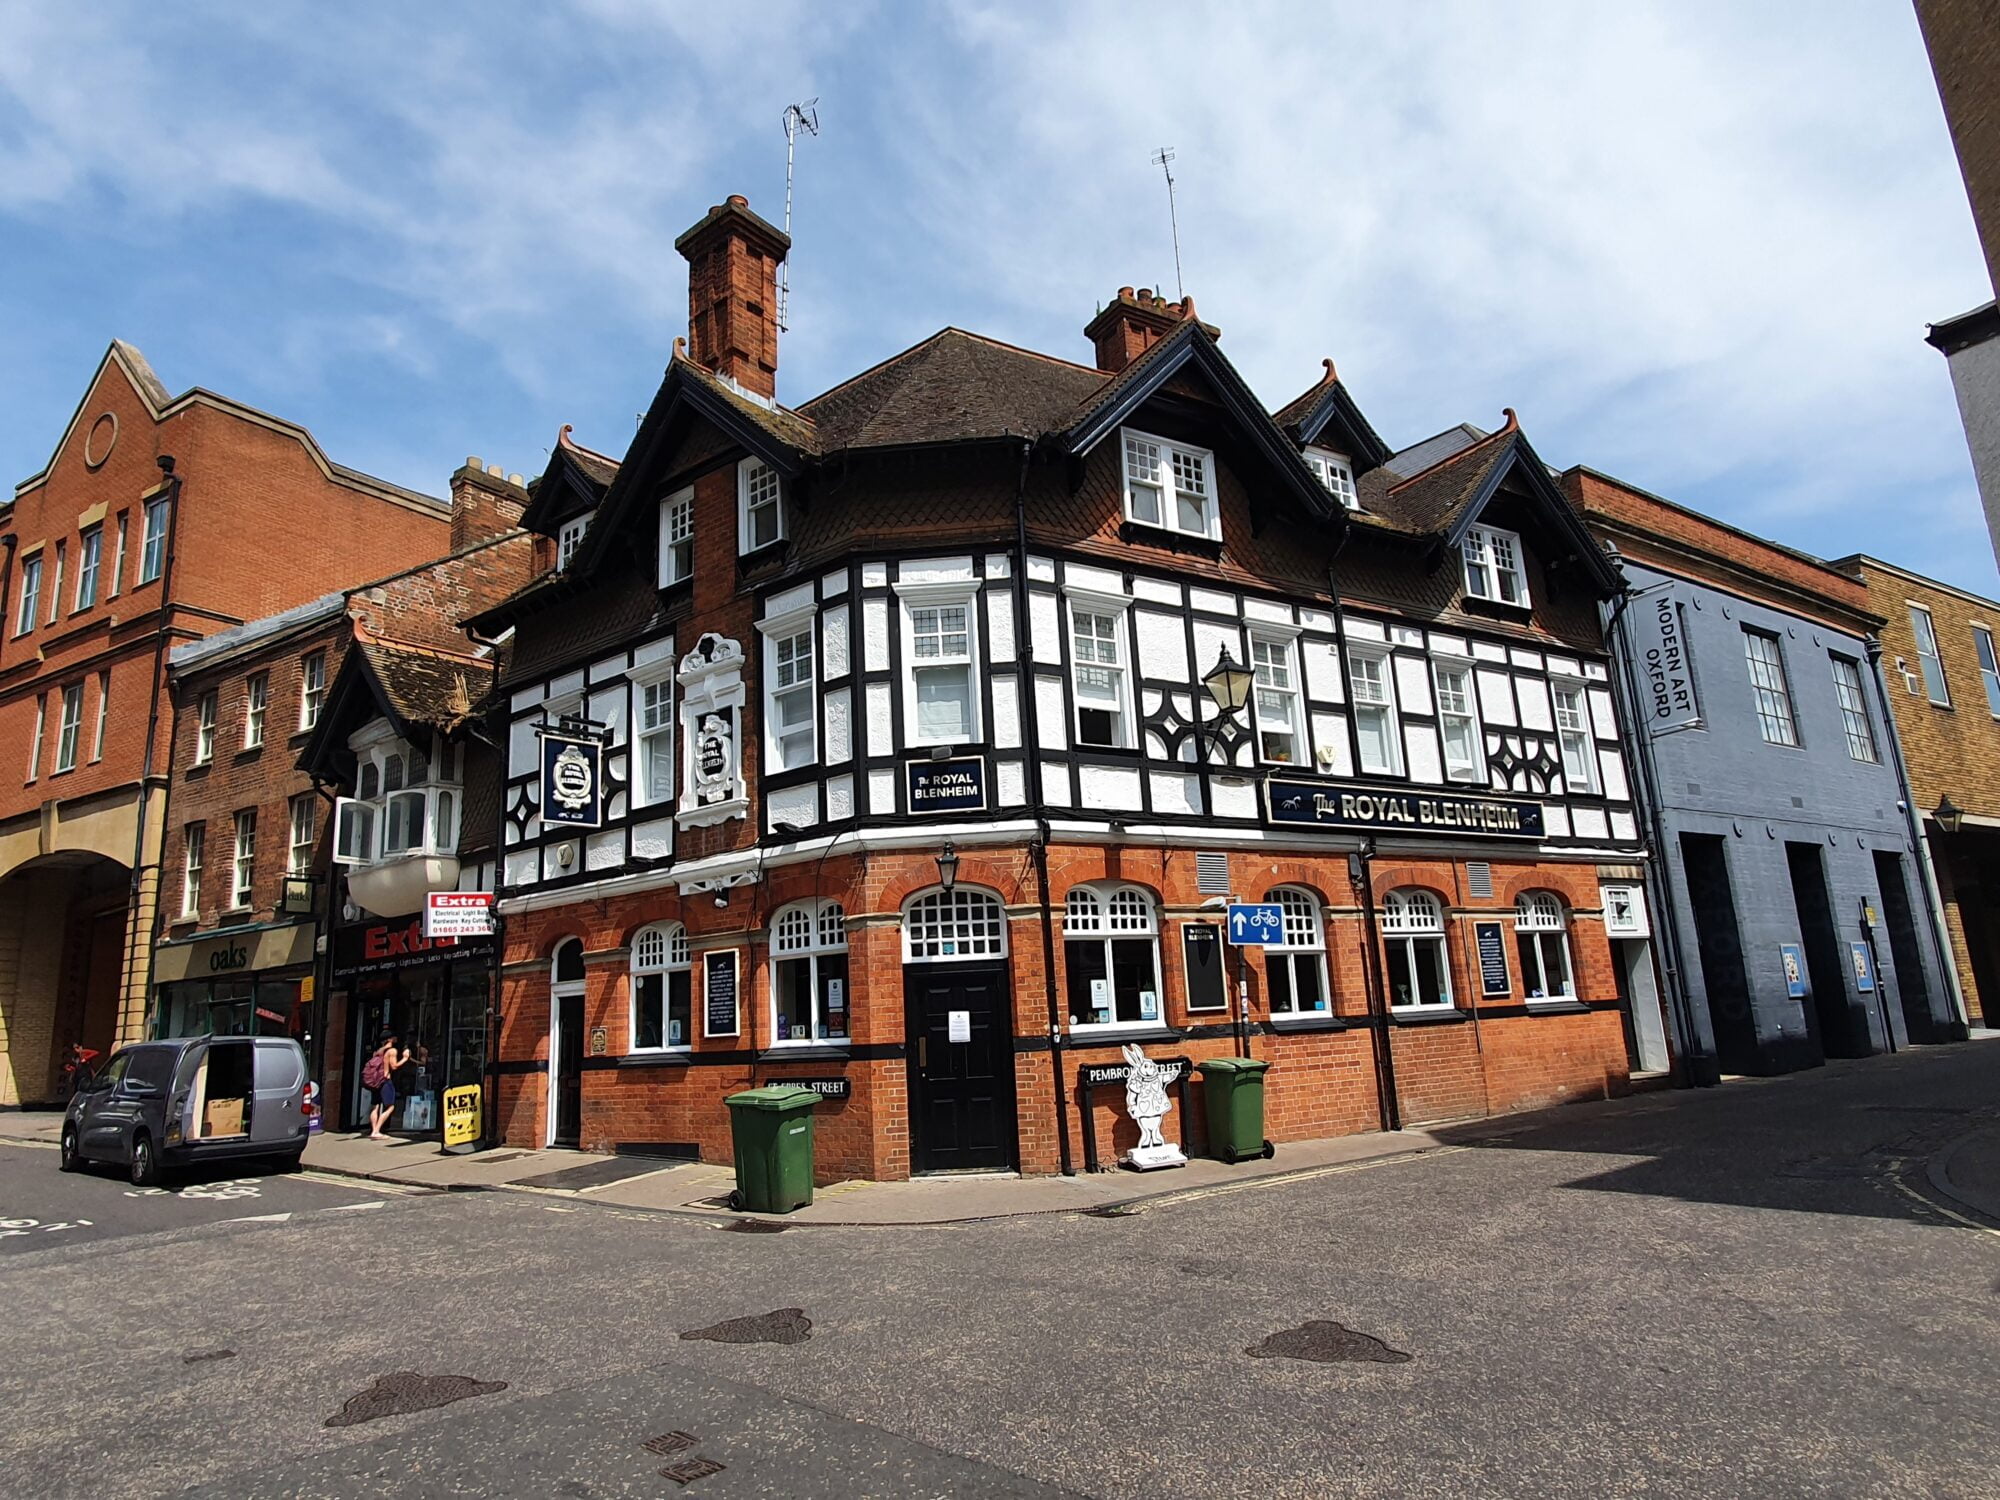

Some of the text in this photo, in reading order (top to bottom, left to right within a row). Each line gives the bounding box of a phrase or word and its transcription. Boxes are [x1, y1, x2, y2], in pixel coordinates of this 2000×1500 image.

[1656, 597, 1691, 711] MODERN ART
[1646, 648, 1671, 718] OXFORD
[705, 740, 717, 749] THE
[933, 773, 974, 785] ROYAL
[914, 785, 978, 799] BLENHEIM
[1313, 793, 1521, 830] The ROYAL BLENHEIM
[436, 896, 486, 906] Extra
[210, 939, 247, 971] oaks
[1090, 1062, 1184, 1082] PEMBRO TREET
[811, 1081, 845, 1093] STREET
[447, 1092, 478, 1110] KEY
[447, 1105, 478, 1116] CUTTING
